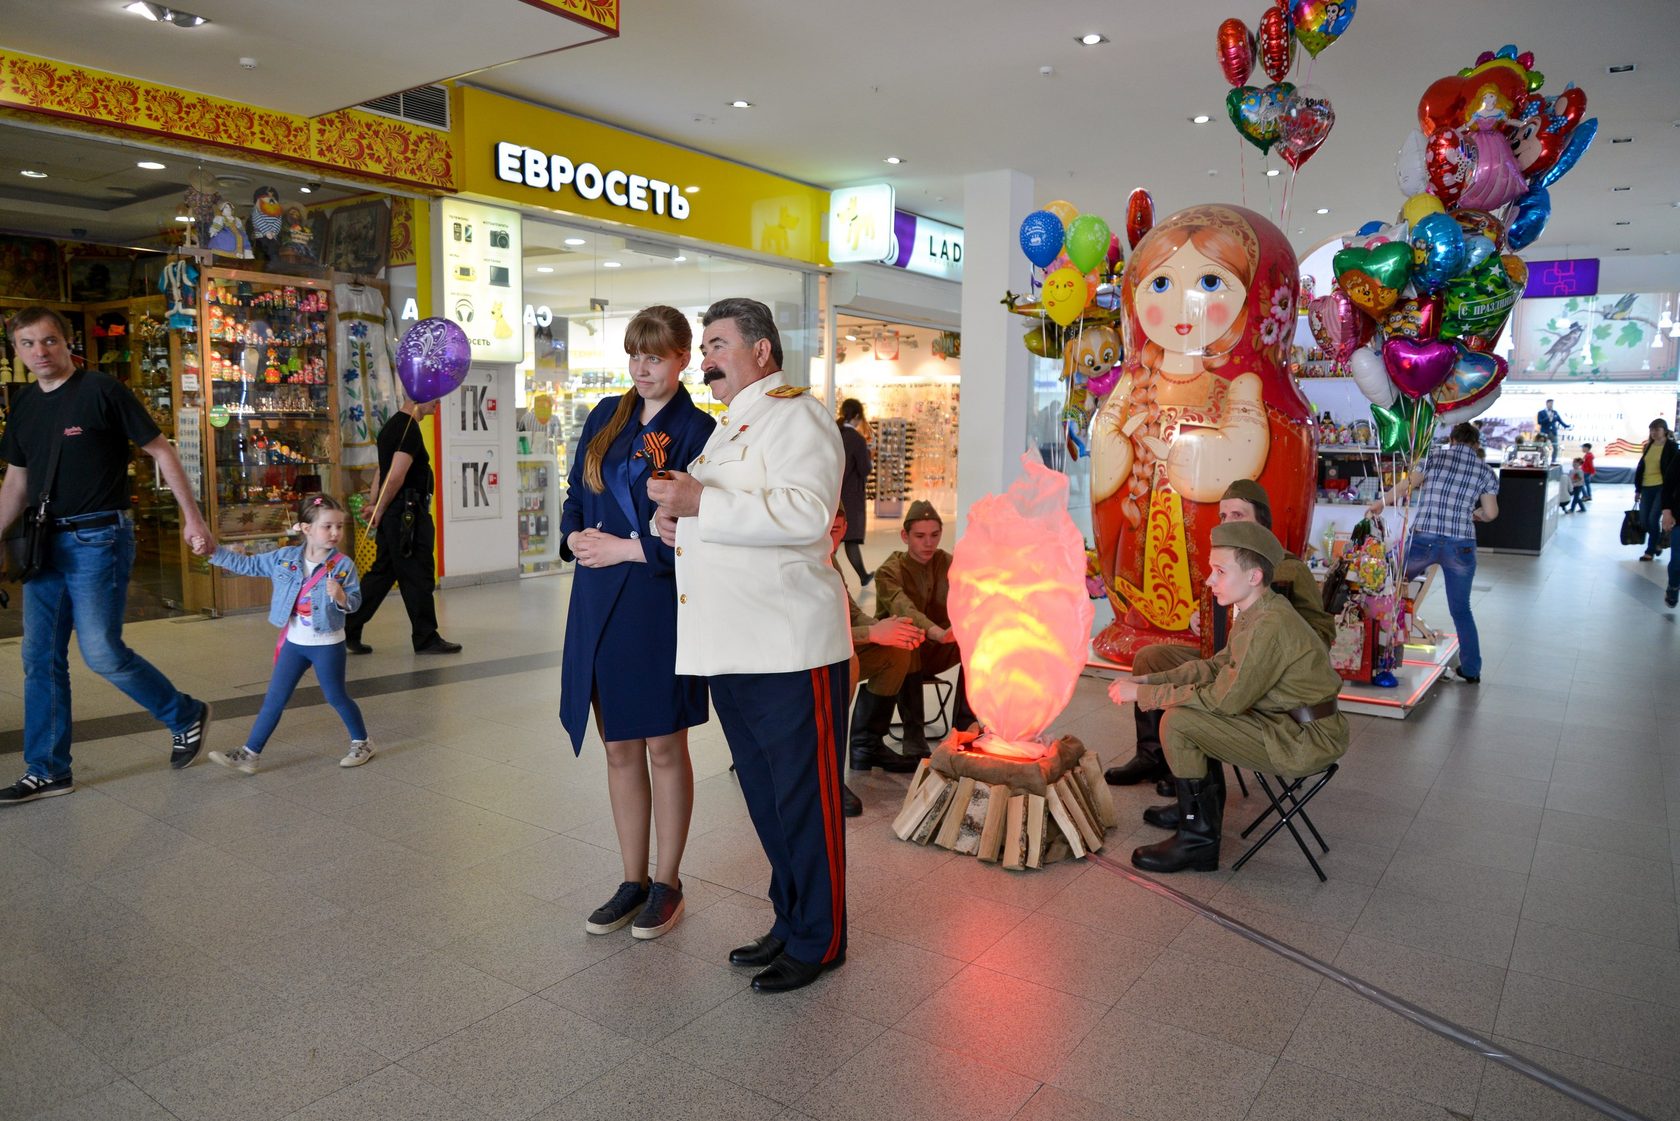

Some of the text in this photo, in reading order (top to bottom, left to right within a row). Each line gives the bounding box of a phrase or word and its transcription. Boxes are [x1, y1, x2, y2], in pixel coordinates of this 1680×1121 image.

[496, 141, 690, 220] ЕВРОСЕТЬ
[460, 385, 488, 432] ПК
[461, 462, 490, 508] ПК
